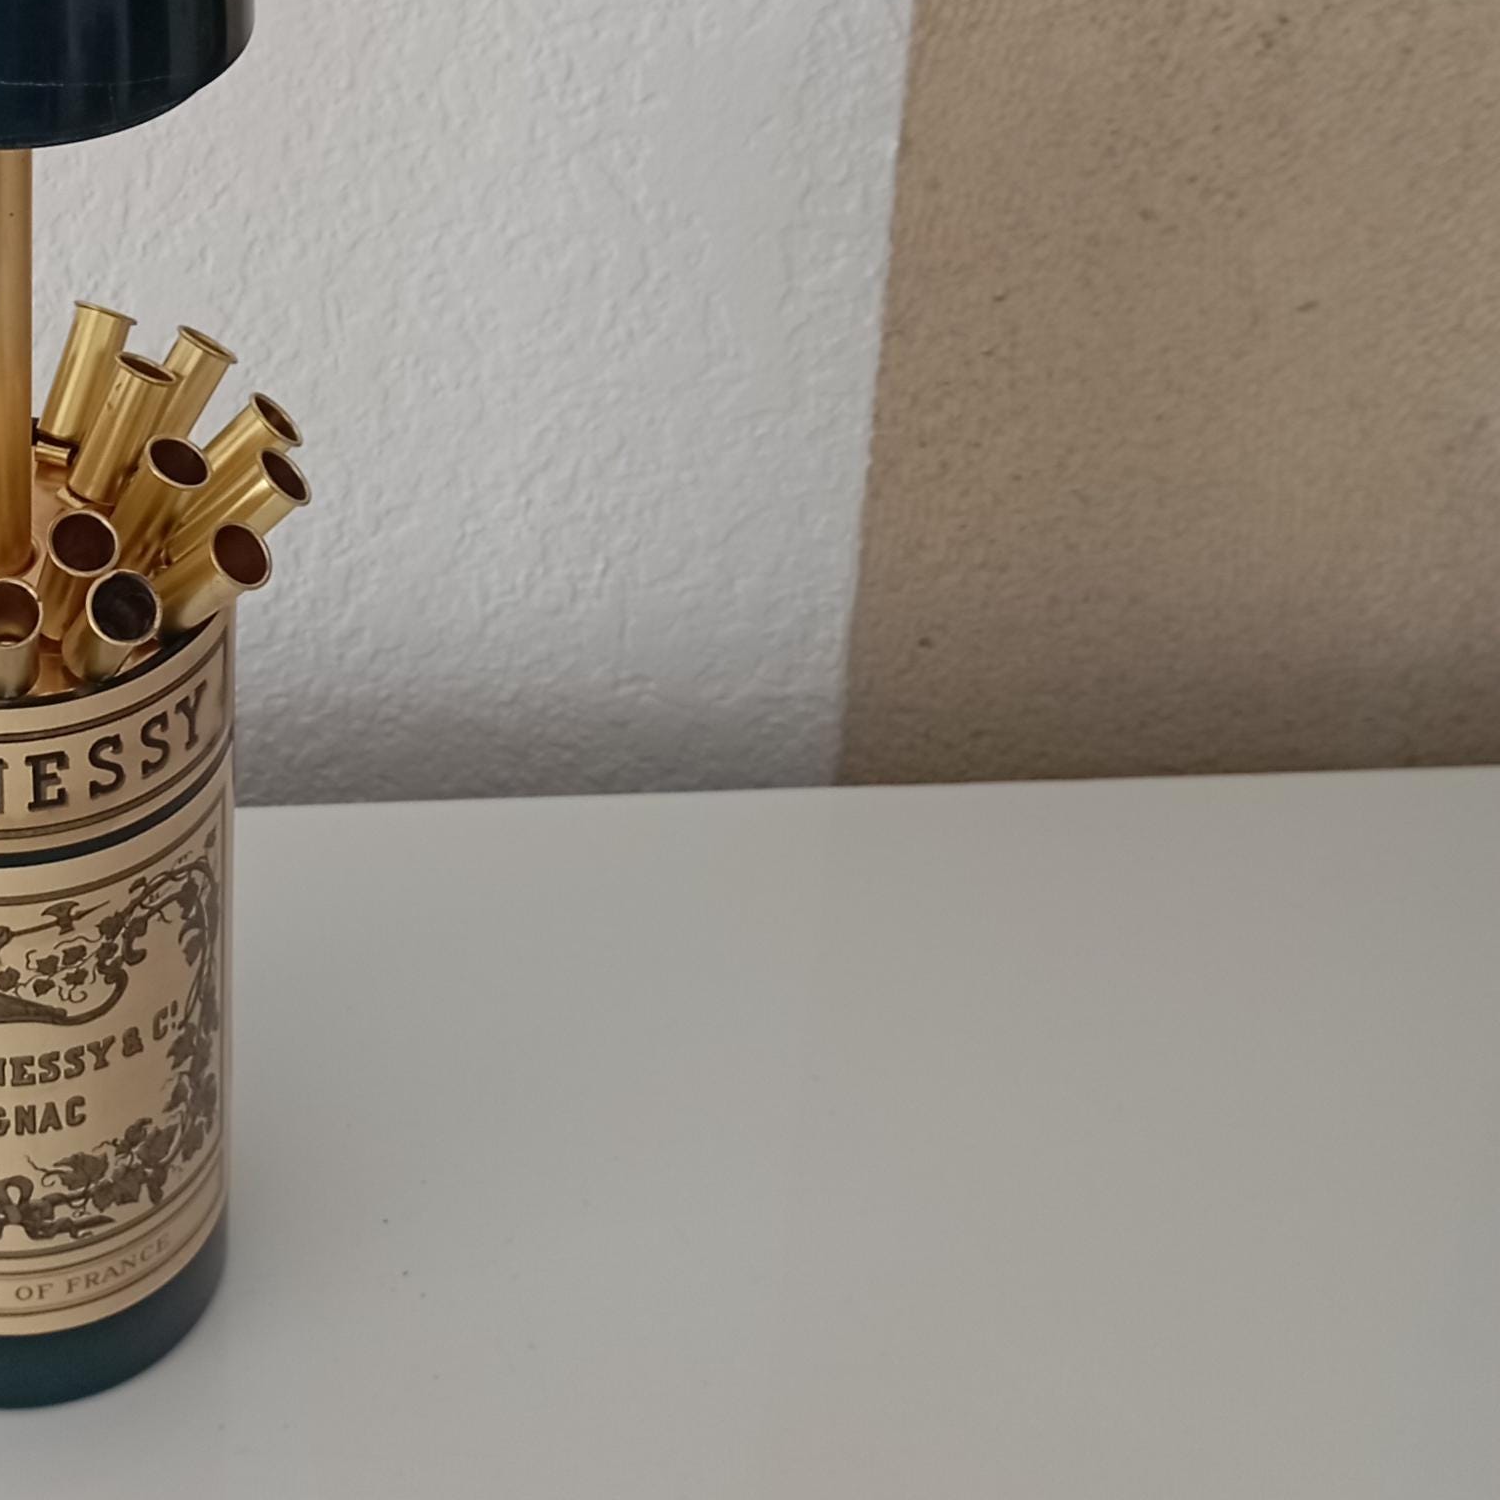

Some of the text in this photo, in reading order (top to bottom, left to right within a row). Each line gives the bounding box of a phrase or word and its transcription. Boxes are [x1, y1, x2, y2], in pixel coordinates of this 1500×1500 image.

[122, 1027, 144, 1058] &
[15, 1282, 52, 1300] OF
[65, 1234, 168, 1295] FRANCE
